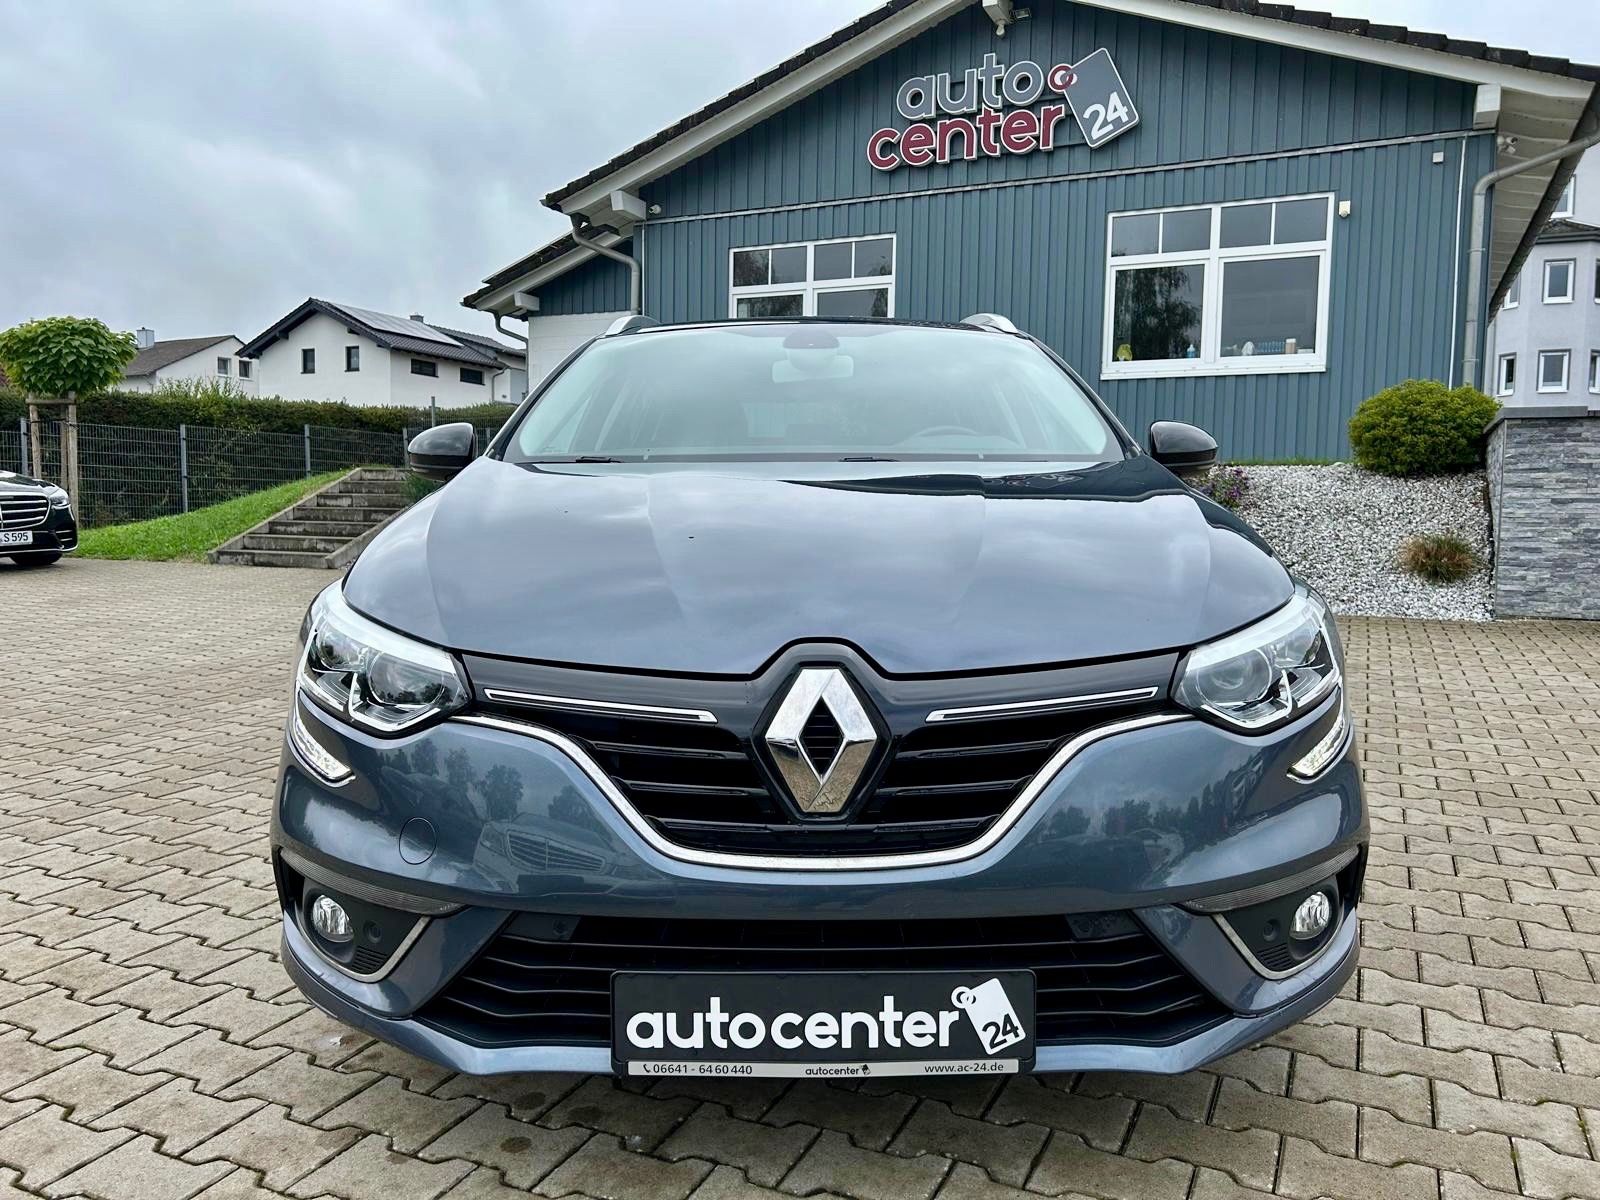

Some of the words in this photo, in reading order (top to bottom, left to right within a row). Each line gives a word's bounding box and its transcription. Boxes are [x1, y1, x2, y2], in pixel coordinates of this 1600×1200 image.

[897, 53, 1044, 120] auto
[1082, 92, 1129, 140] 24
[867, 104, 1065, 171] center
[3, 532, 10, 542] S
[11, 532, 28, 542] 595
[982, 1013, 1020, 1049] 24
[653, 1064, 688, 1074] 06641
[805, 1066, 860, 1075] autocenter
[924, 1061, 1004, 1073] www.ac-24.de
